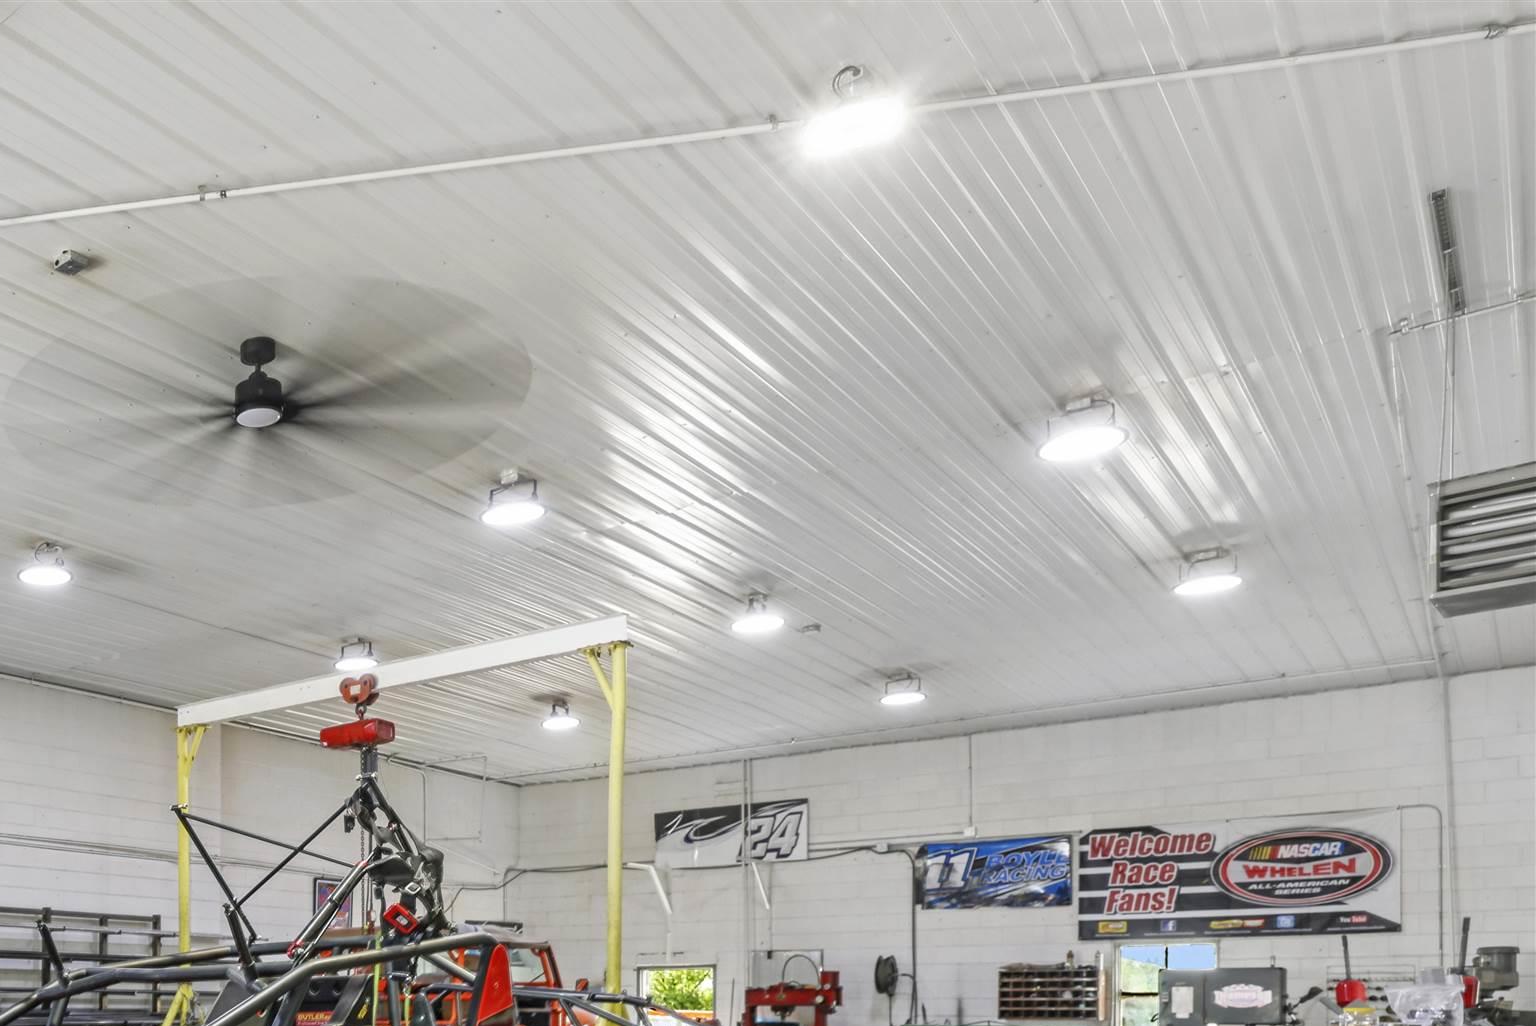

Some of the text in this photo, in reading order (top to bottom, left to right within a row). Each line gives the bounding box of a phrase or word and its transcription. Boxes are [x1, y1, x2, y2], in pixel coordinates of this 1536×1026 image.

[738, 811, 803, 860] 24
[1087, 831, 1216, 860] Welcome
[1276, 841, 1344, 859] NASCAR
[926, 847, 978, 891] 11
[981, 863, 1071, 884] RACING
[1108, 862, 1179, 886] Race
[1242, 858, 1357, 879] WHELEN
[1247, 879, 1351, 891] ALL-AMERICAN
[1273, 886, 1322, 896] SERIES
[1104, 888, 1178, 914] Fans!
